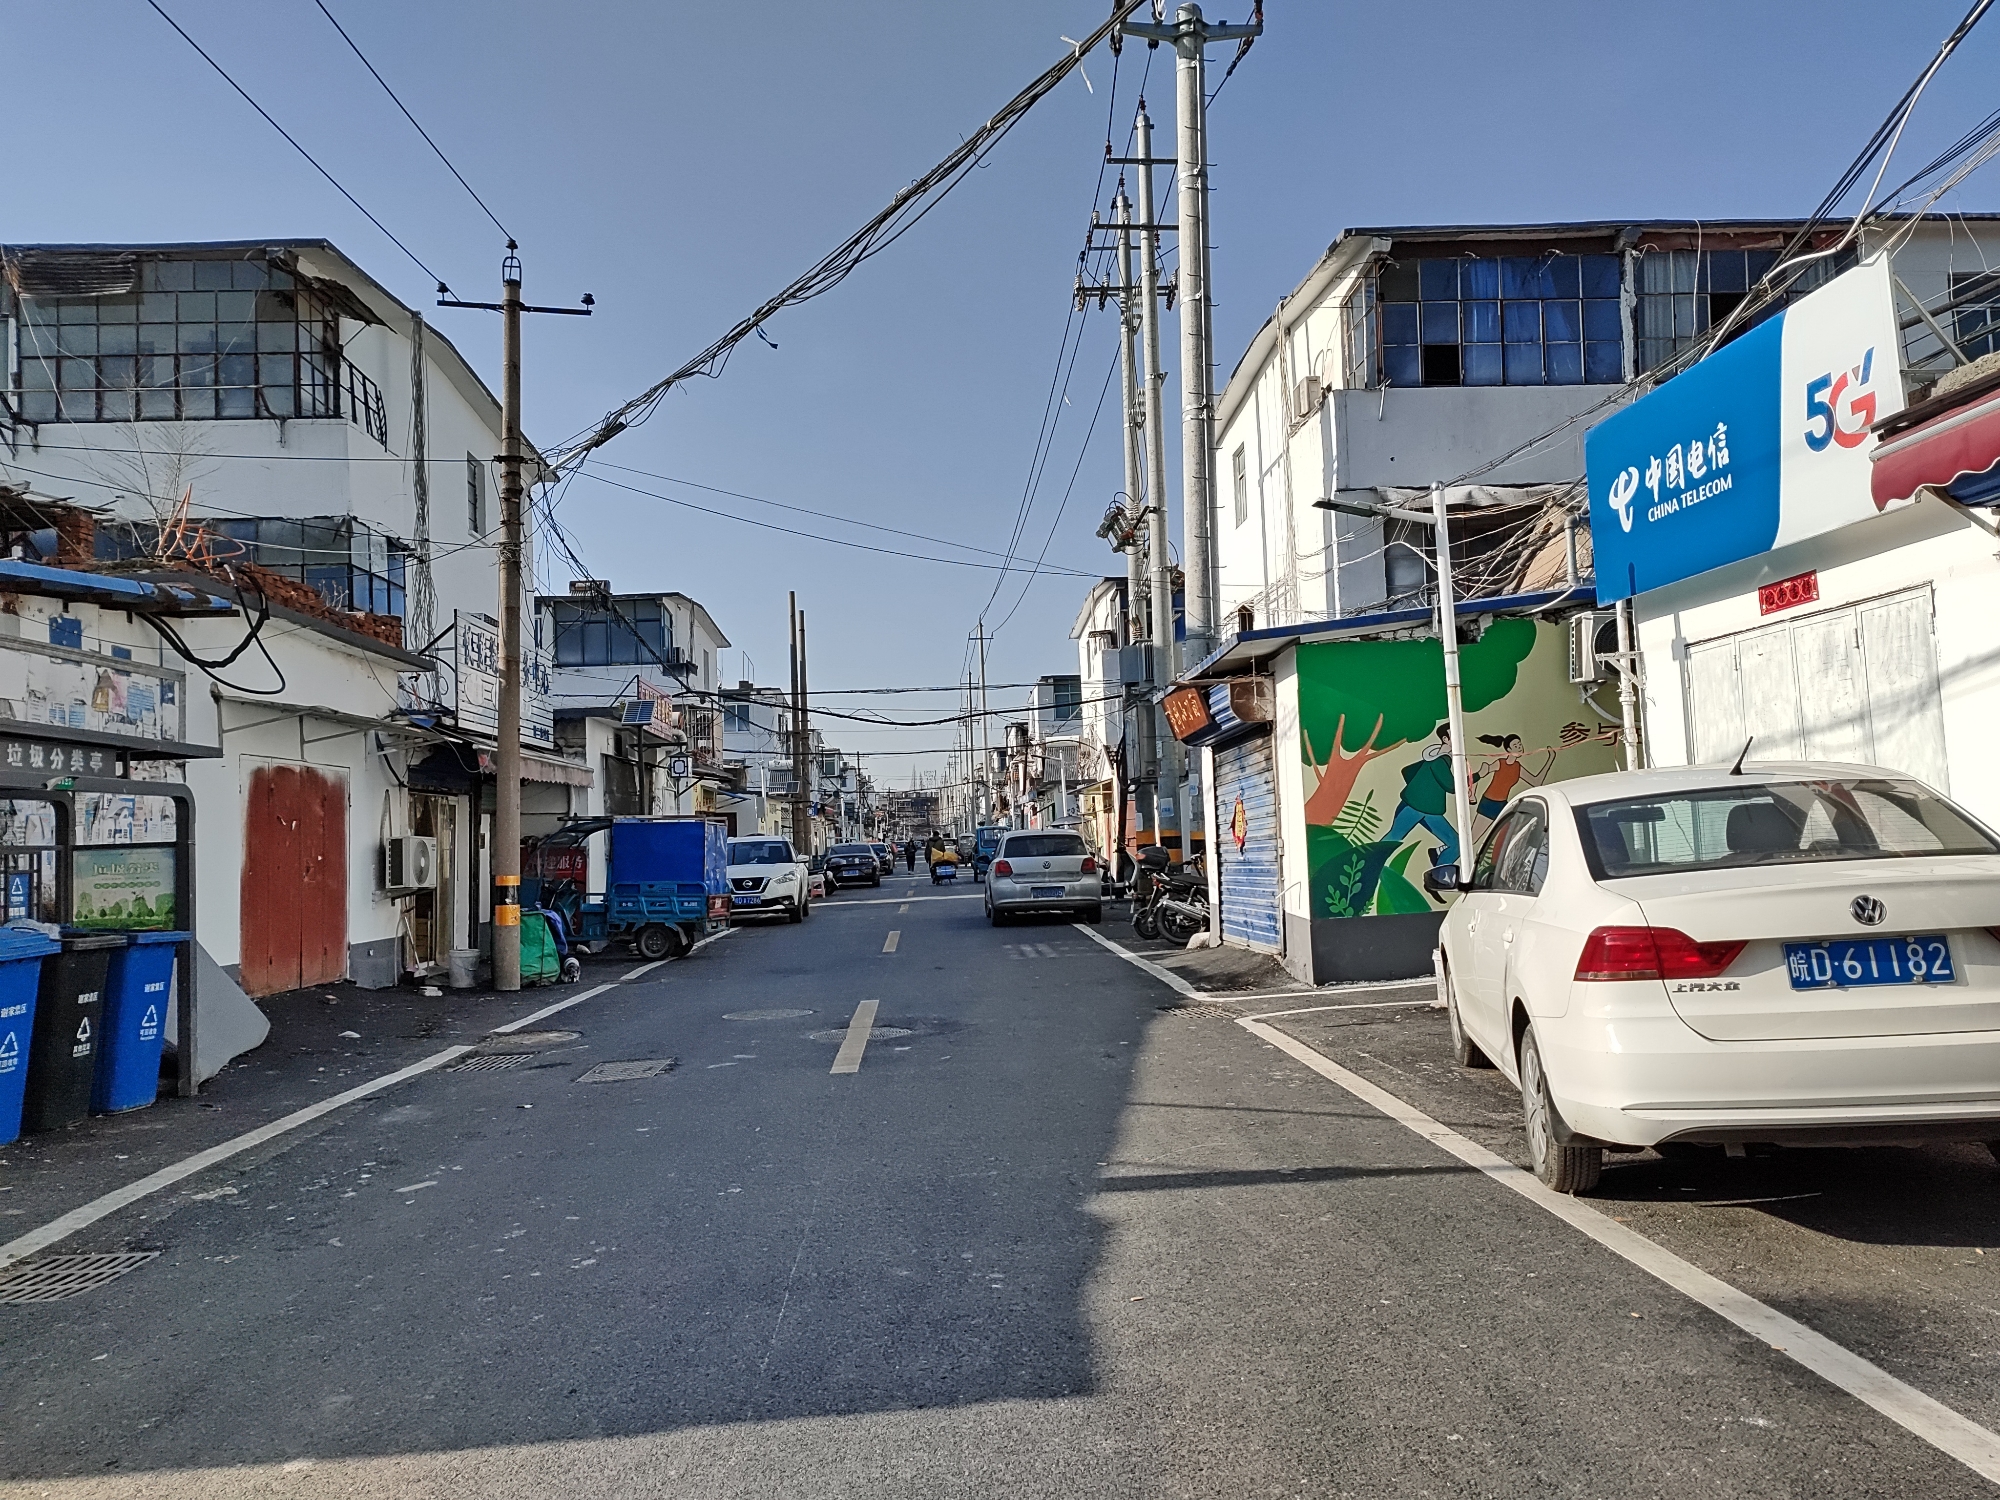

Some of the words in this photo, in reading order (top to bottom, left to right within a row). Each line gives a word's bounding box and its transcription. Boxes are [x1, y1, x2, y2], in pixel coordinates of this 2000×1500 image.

[1804, 368, 1876, 452] 5G
[1645, 422, 1730, 503] 中国电信
[1647, 497, 1680, 522] CHINA
[1680, 473, 1733, 508] TELECOM
[7, 743, 103, 773] 垃圾分类亭
[92, 862, 159, 877] 垃圾分类
[1672, 981, 1741, 994] 上汽大众
